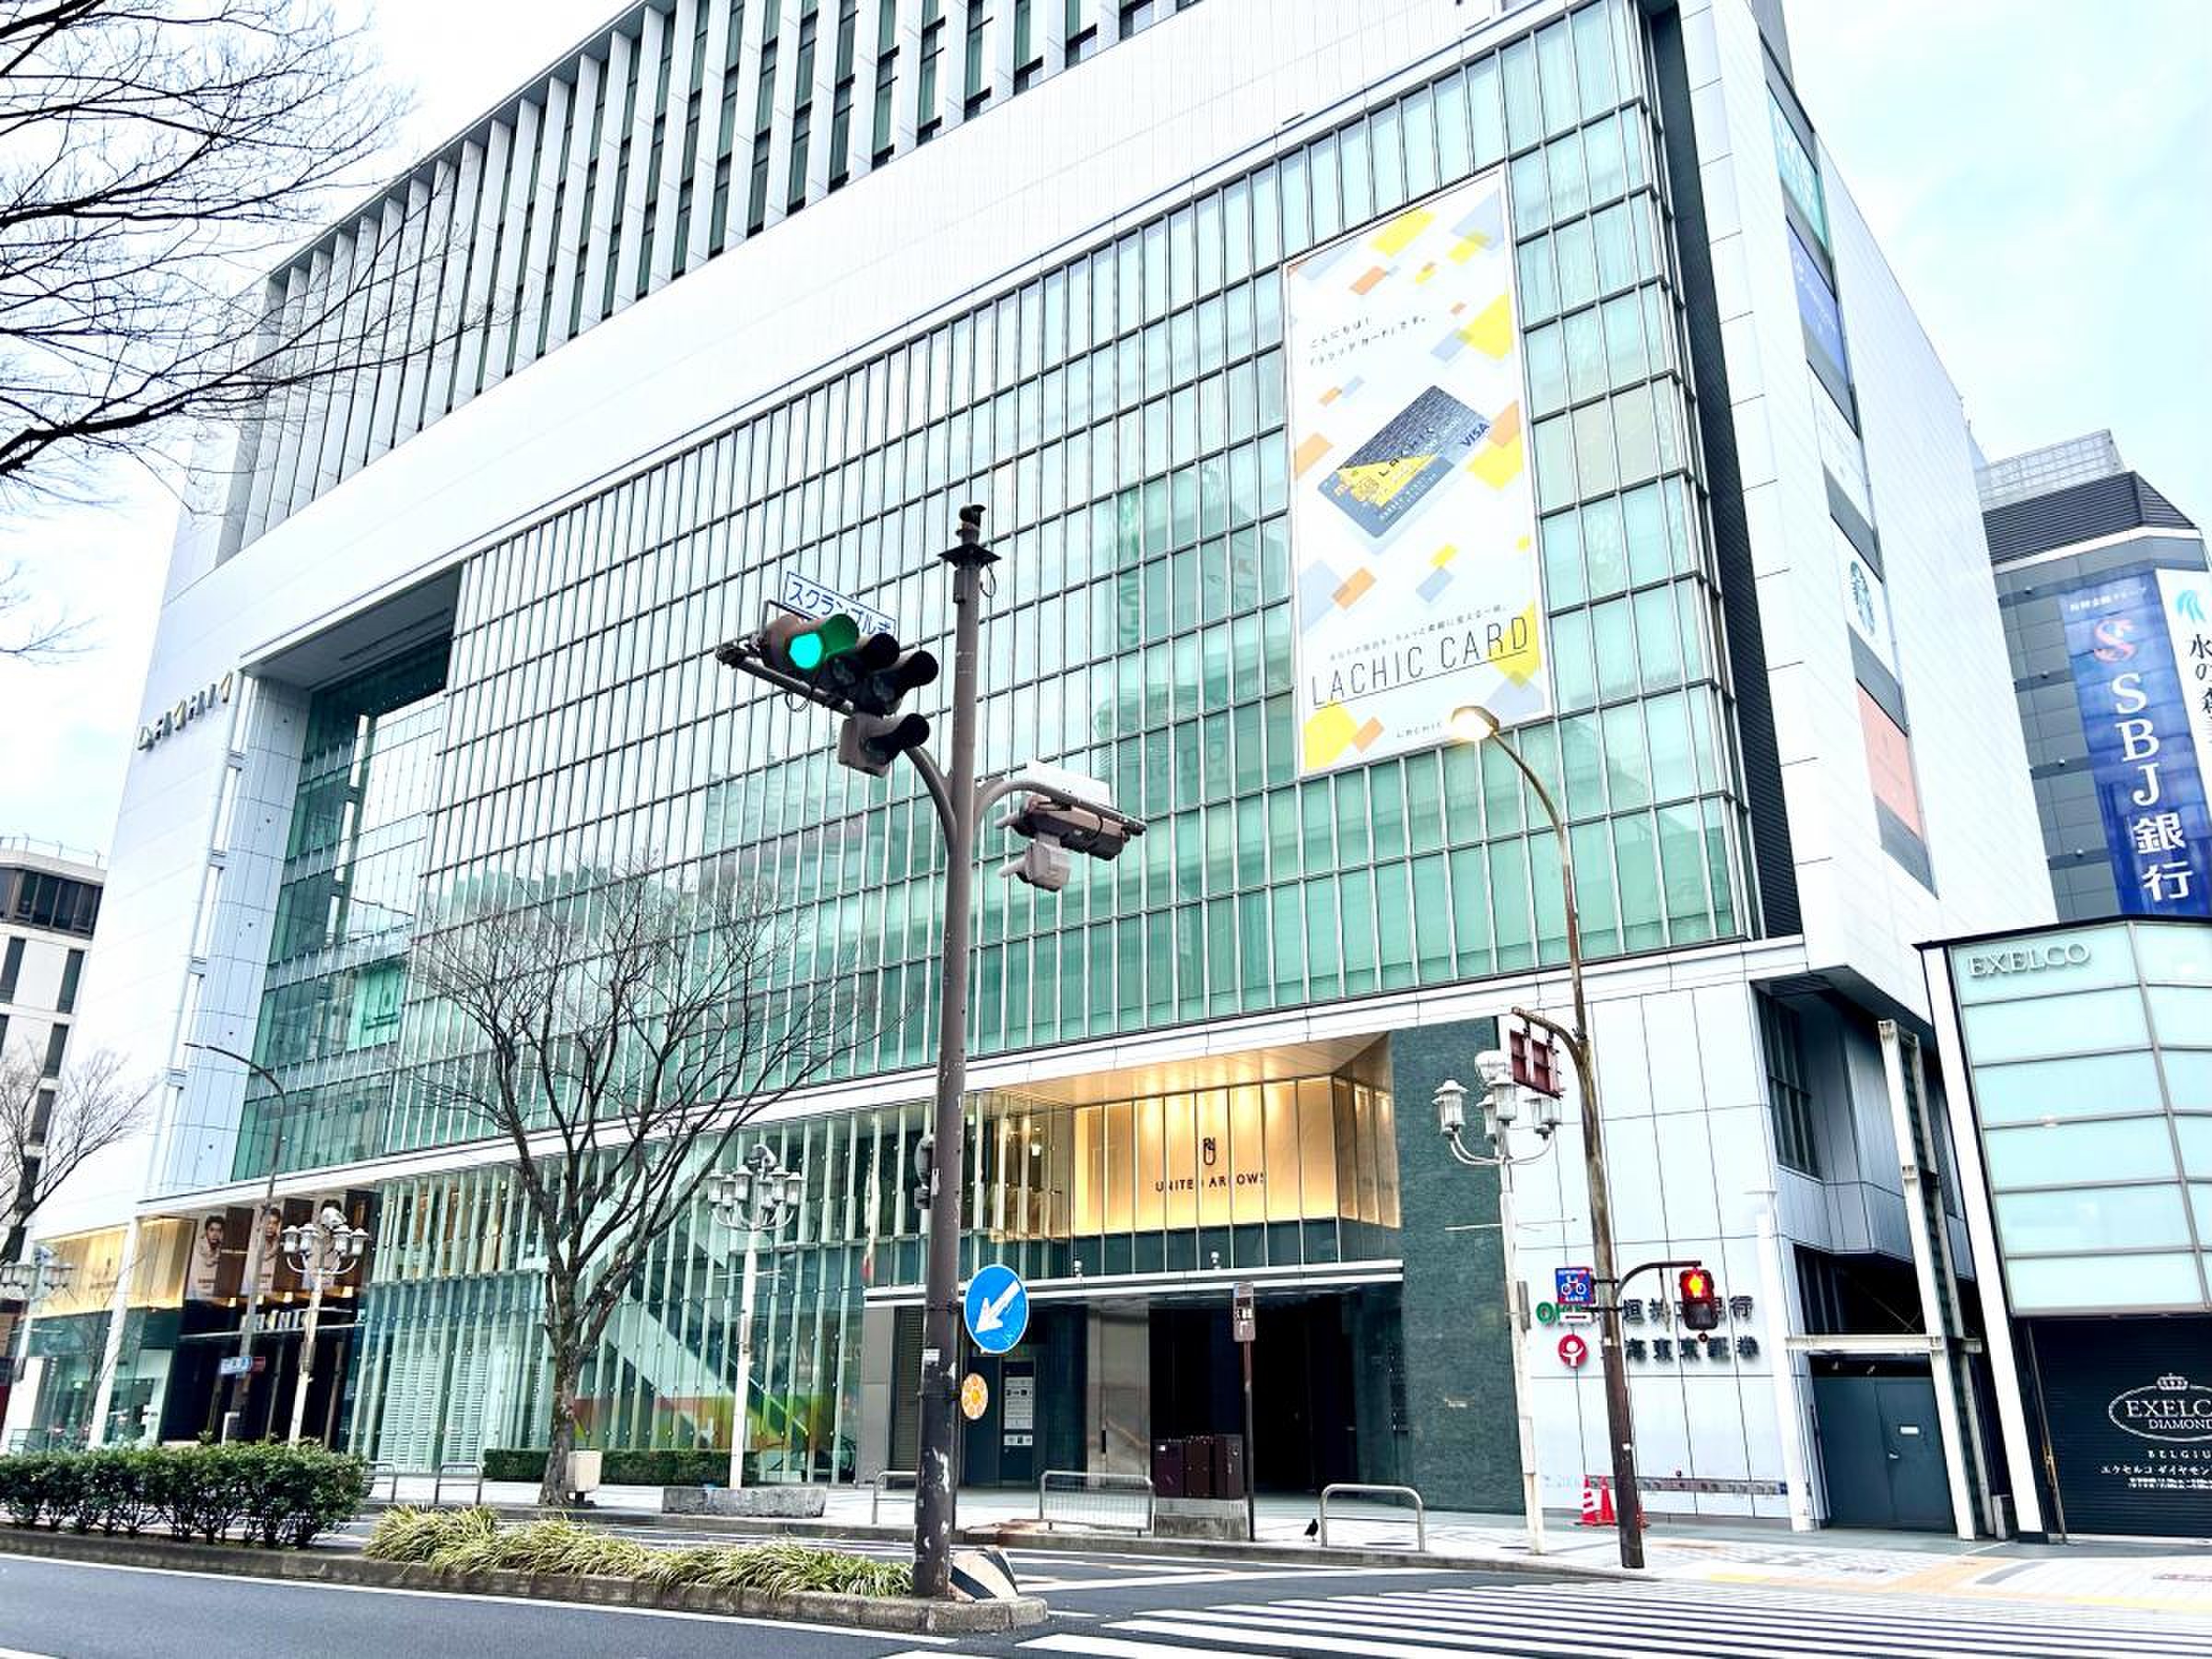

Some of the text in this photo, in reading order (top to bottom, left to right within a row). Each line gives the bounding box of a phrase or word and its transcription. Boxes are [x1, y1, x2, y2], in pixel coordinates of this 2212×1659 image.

[1460, 421, 1490, 448] VISA
[1312, 617, 1528, 706] LACHIC CARD
[2112, 672, 2194, 902] SBJ銀行
[1969, 943, 2091, 977] EXELCO
[1156, 1171, 1265, 1193] UNITE AROW
